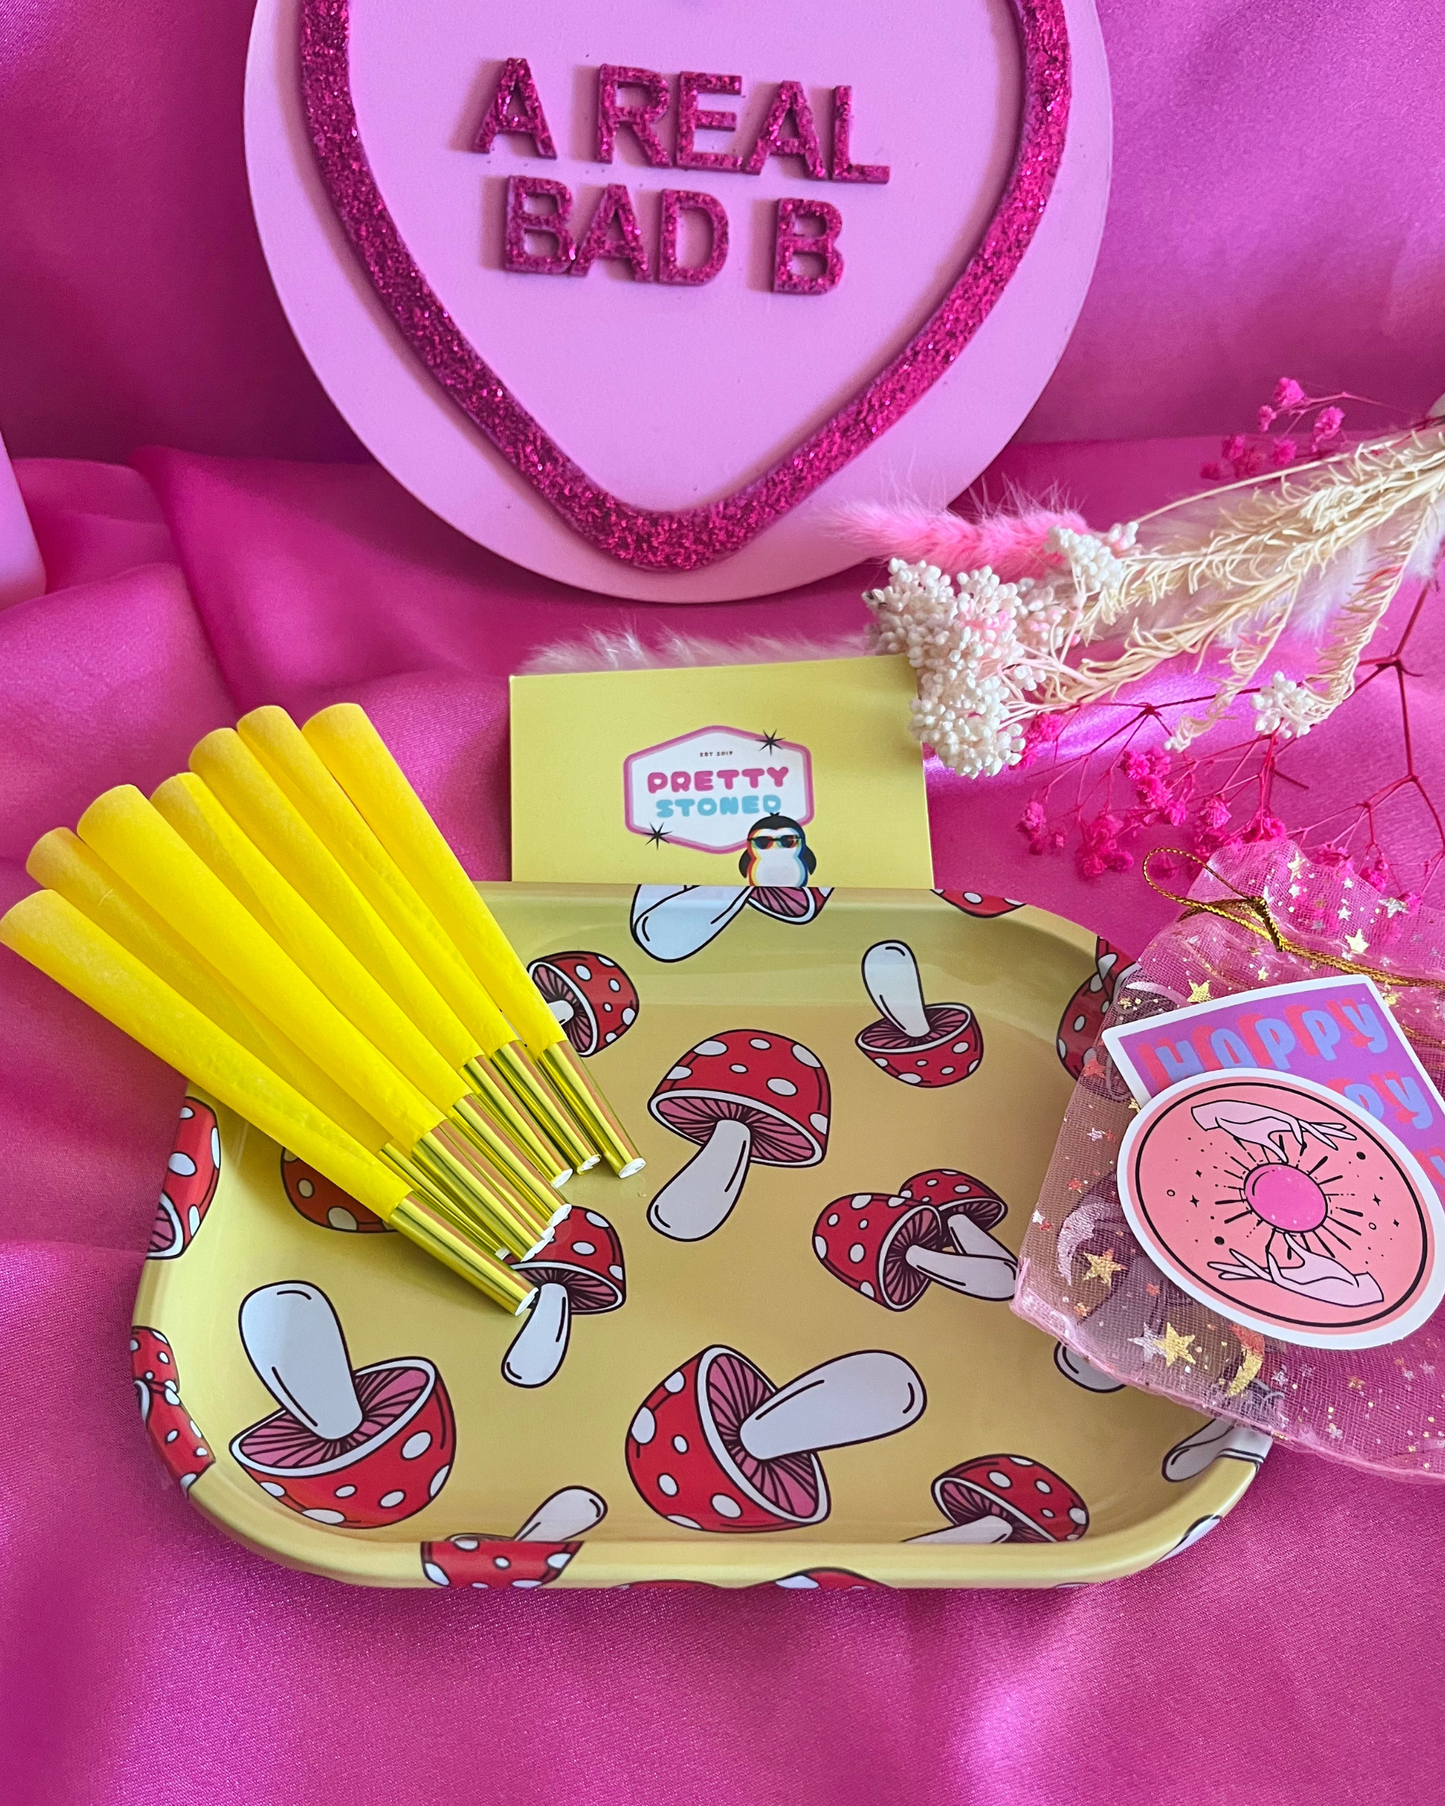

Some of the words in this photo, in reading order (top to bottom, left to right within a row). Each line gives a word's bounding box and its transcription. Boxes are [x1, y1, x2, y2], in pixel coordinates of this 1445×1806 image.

[472, 57, 557, 159] A
[596, 64, 890, 184] REAL
[504, 175, 729, 286] BAD
[772, 198, 844, 295] B
[647, 767, 789, 794] PRETTY
[655, 795, 782, 818] STONED
